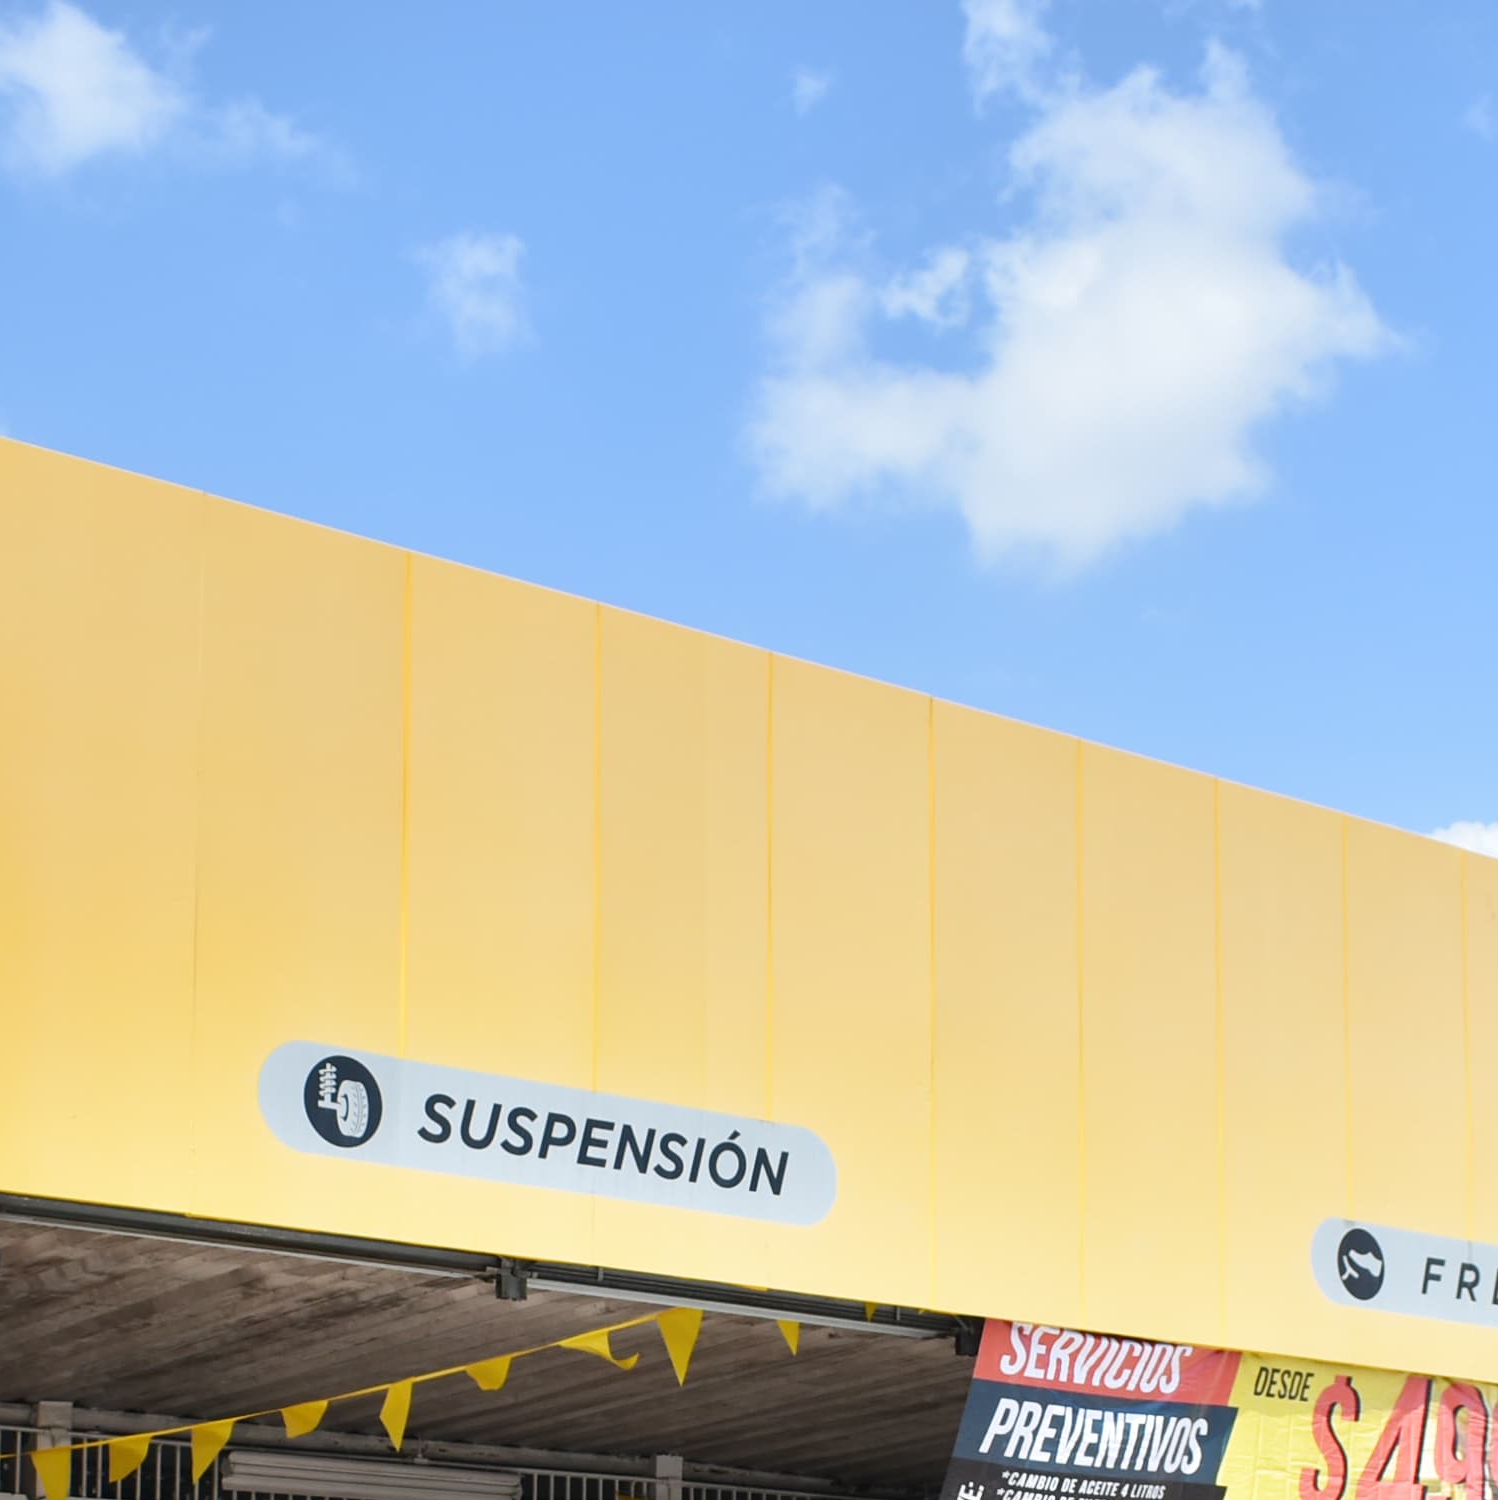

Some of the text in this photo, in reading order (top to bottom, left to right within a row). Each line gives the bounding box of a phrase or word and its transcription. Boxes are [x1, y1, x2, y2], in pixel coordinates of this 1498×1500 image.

[417, 1093, 790, 1195] SUSPENSIÓN
[999, 1321, 1193, 1394] SERVICIOS
[1253, 1366, 1314, 1402] DESDE
[978, 1397, 1209, 1475] PREVENTIVOS
[1061, 1478, 1078, 1493] DE
[1079, 1480, 1118, 1497] ACEITE
[1120, 1483, 1128, 1497] 4
[1130, 1484, 1166, 1500] LITROS
